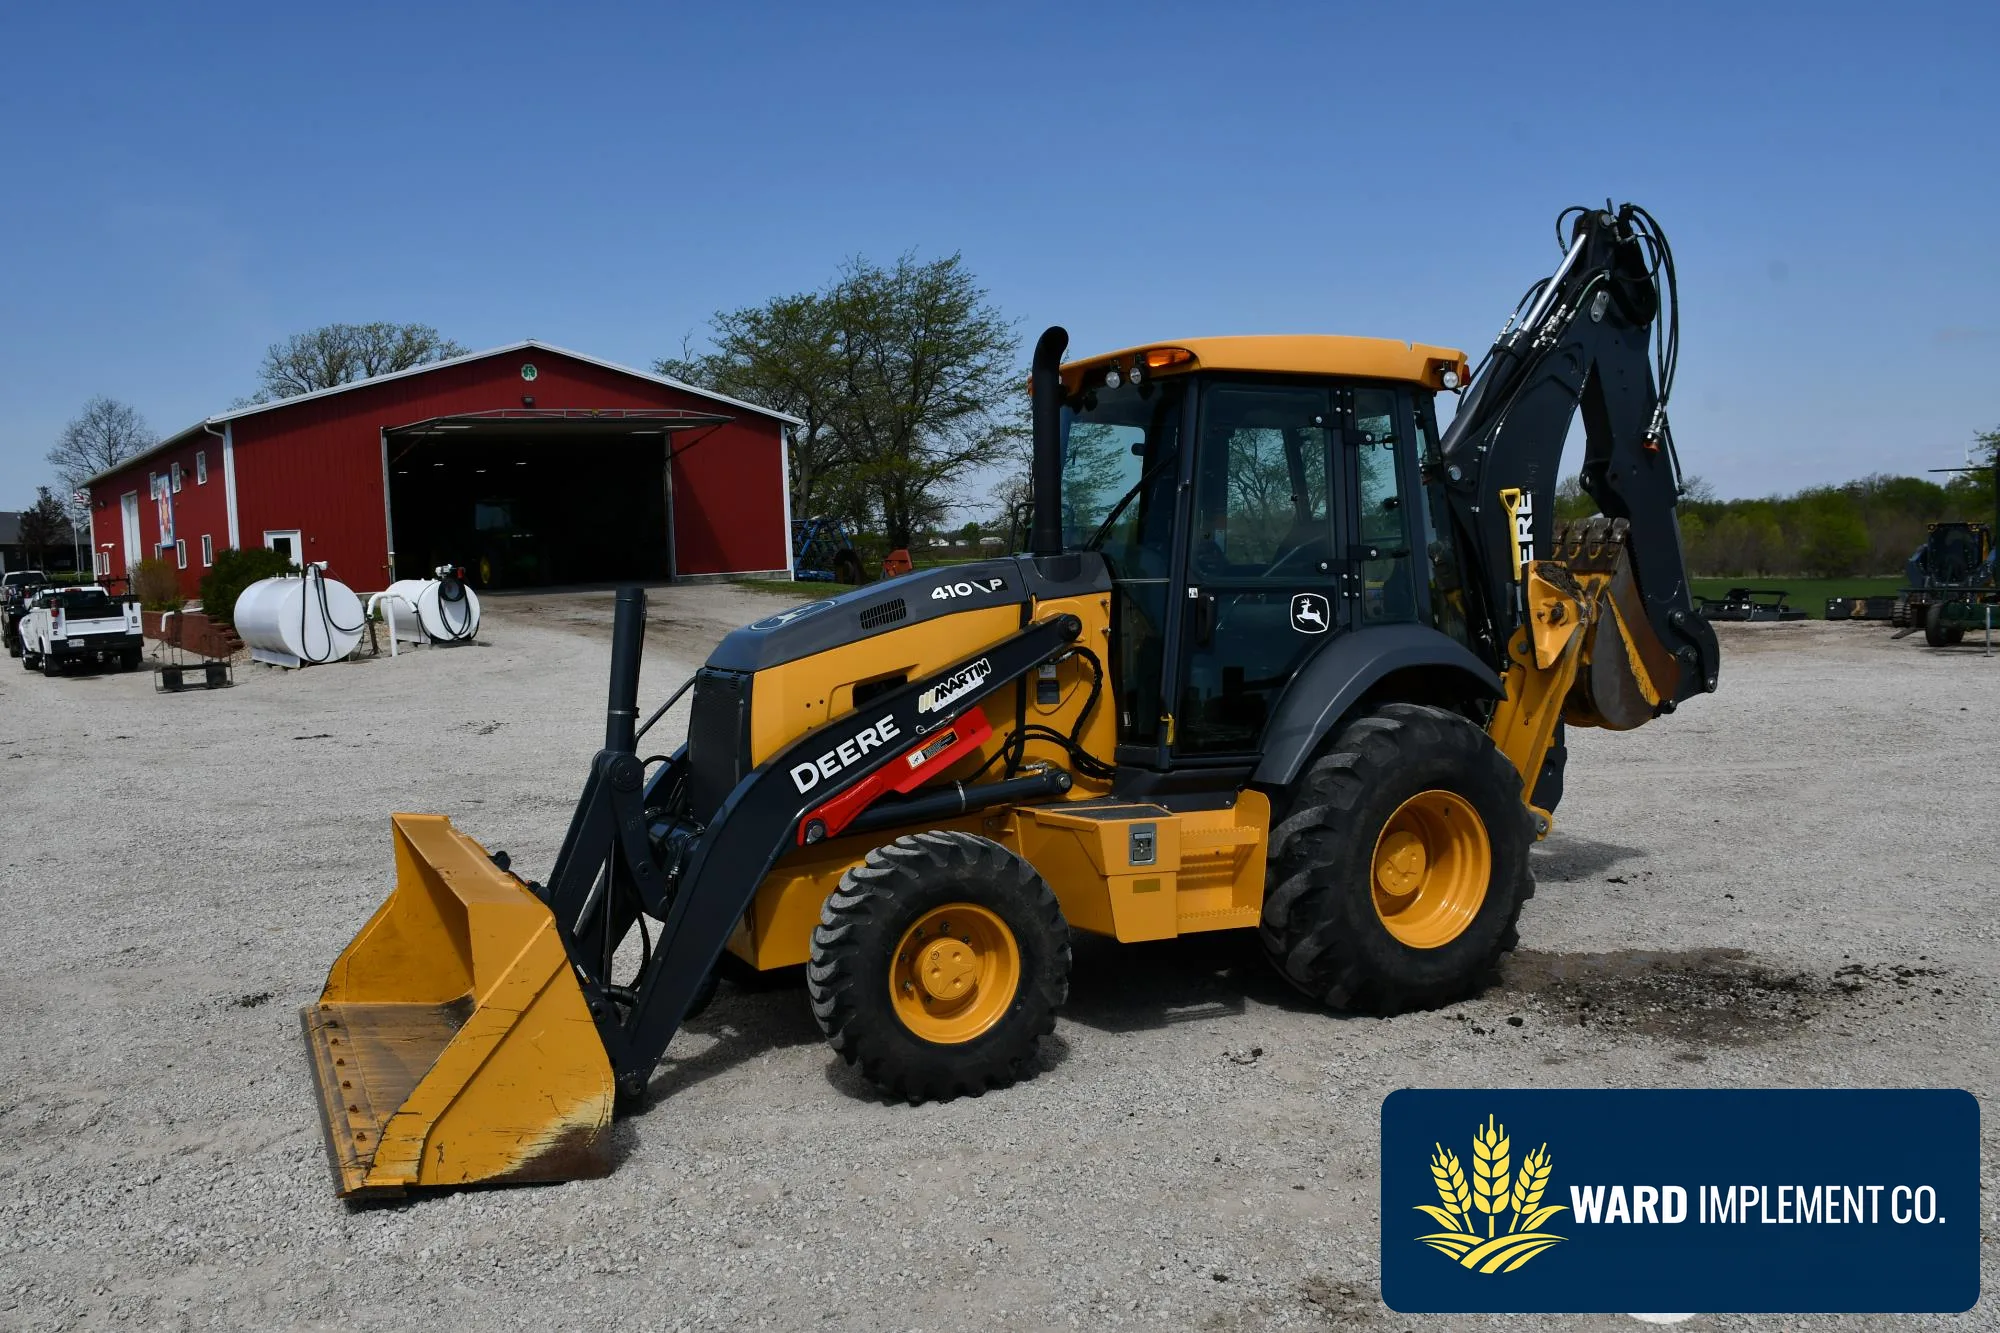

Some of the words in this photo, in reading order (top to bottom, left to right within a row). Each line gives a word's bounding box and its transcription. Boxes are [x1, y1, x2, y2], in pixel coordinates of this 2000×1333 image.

[1516, 491, 1534, 569] ERE
[934, 658, 991, 703] MARTIN
[789, 713, 901, 795] DEERE
